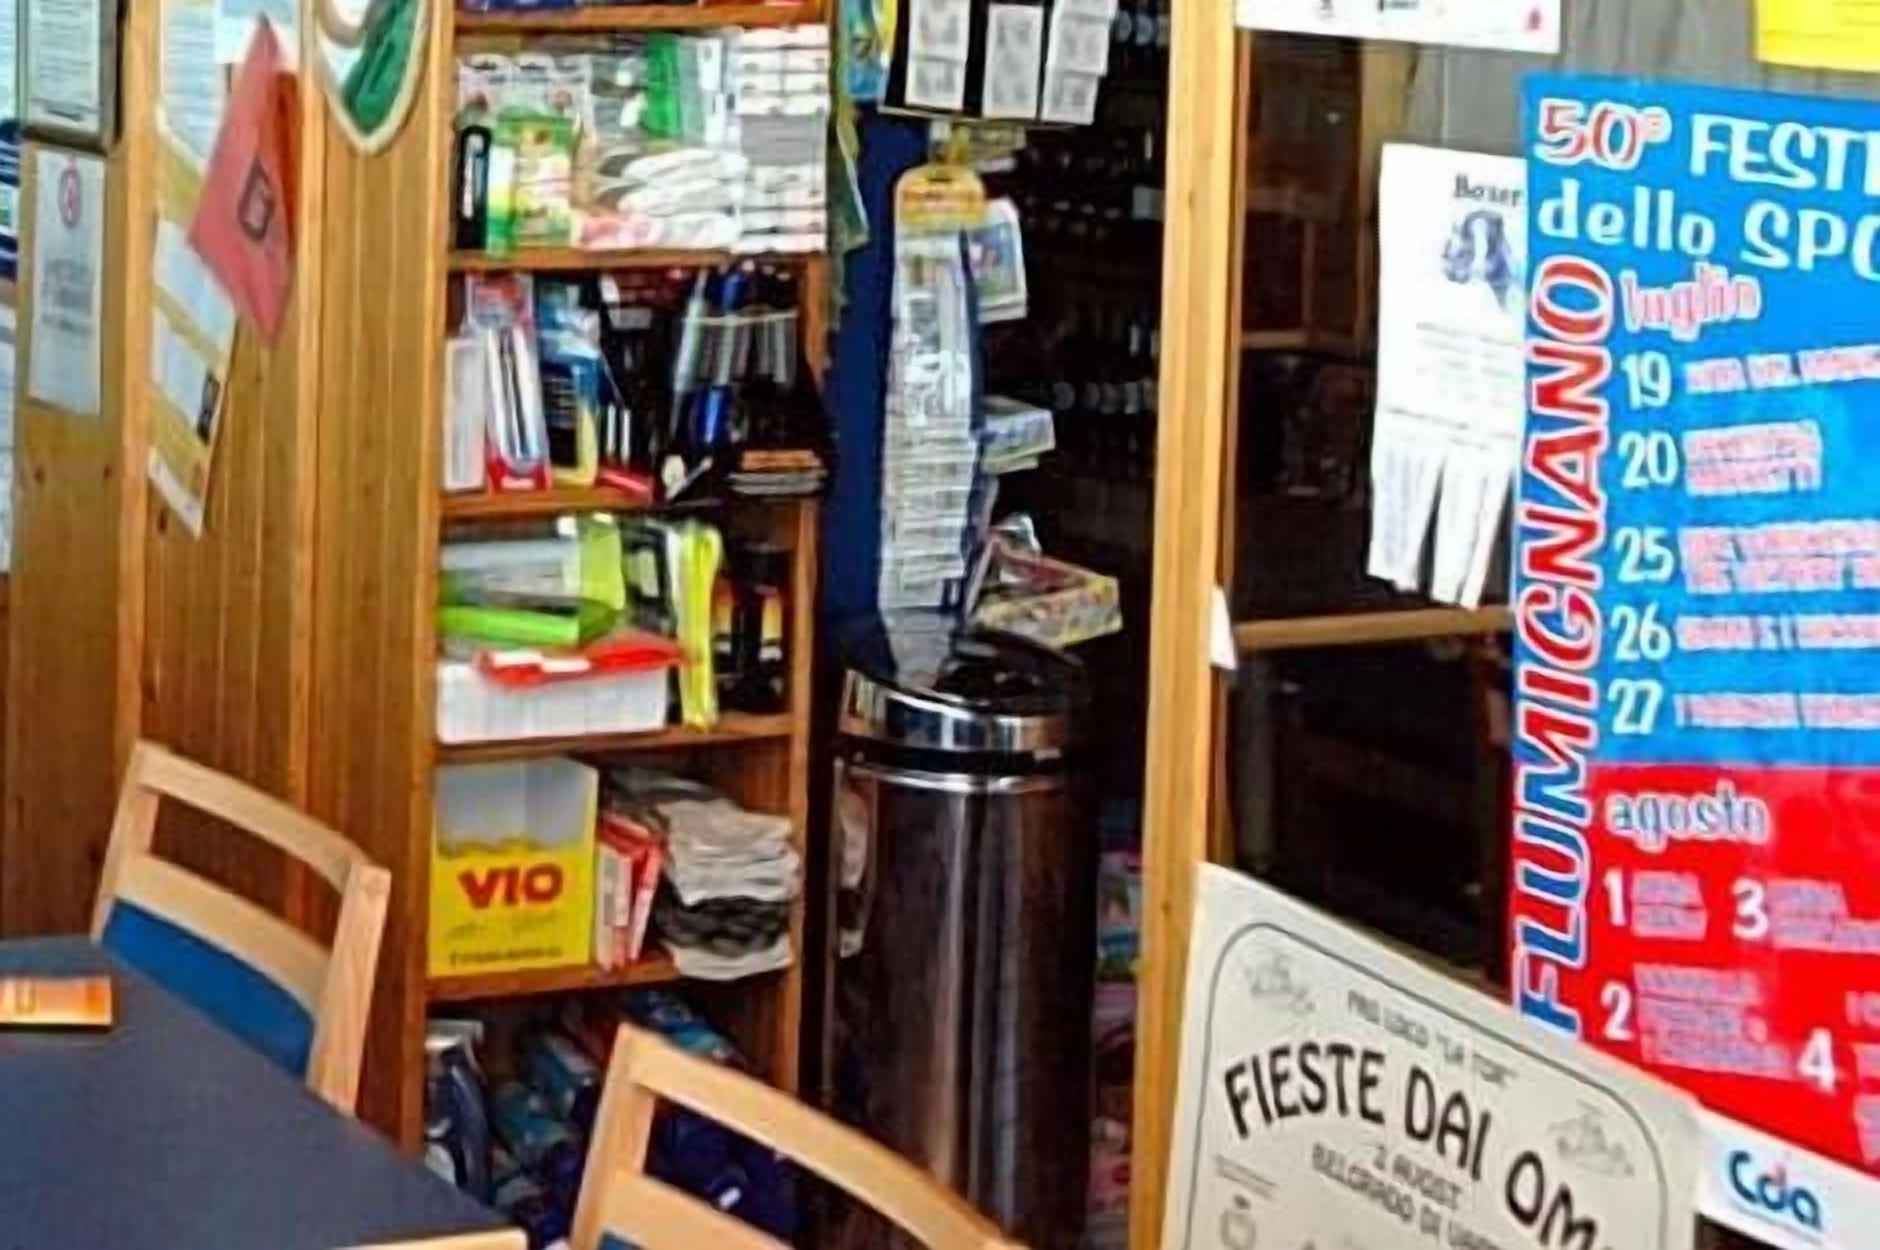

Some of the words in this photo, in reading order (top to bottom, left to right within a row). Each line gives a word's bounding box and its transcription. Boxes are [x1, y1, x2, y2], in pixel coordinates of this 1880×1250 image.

[1538, 178, 1716, 256] dello
[1620, 351, 1671, 410] 19
[1619, 431, 1679, 489] 20
[1615, 526, 1674, 582] 25
[1510, 253, 1614, 1041] FLUMIGNANO
[1611, 602, 1672, 661] 26
[1608, 680, 1663, 734] 27
[458, 862, 565, 910] VIO
[1604, 868, 1627, 927] 1
[1732, 877, 1770, 940] 3
[1600, 980, 1634, 1041] 2
[1797, 1027, 1838, 1093] 4
[1224, 1042, 1386, 1139] FIESTE
[1404, 1065, 1492, 1182] DAI
